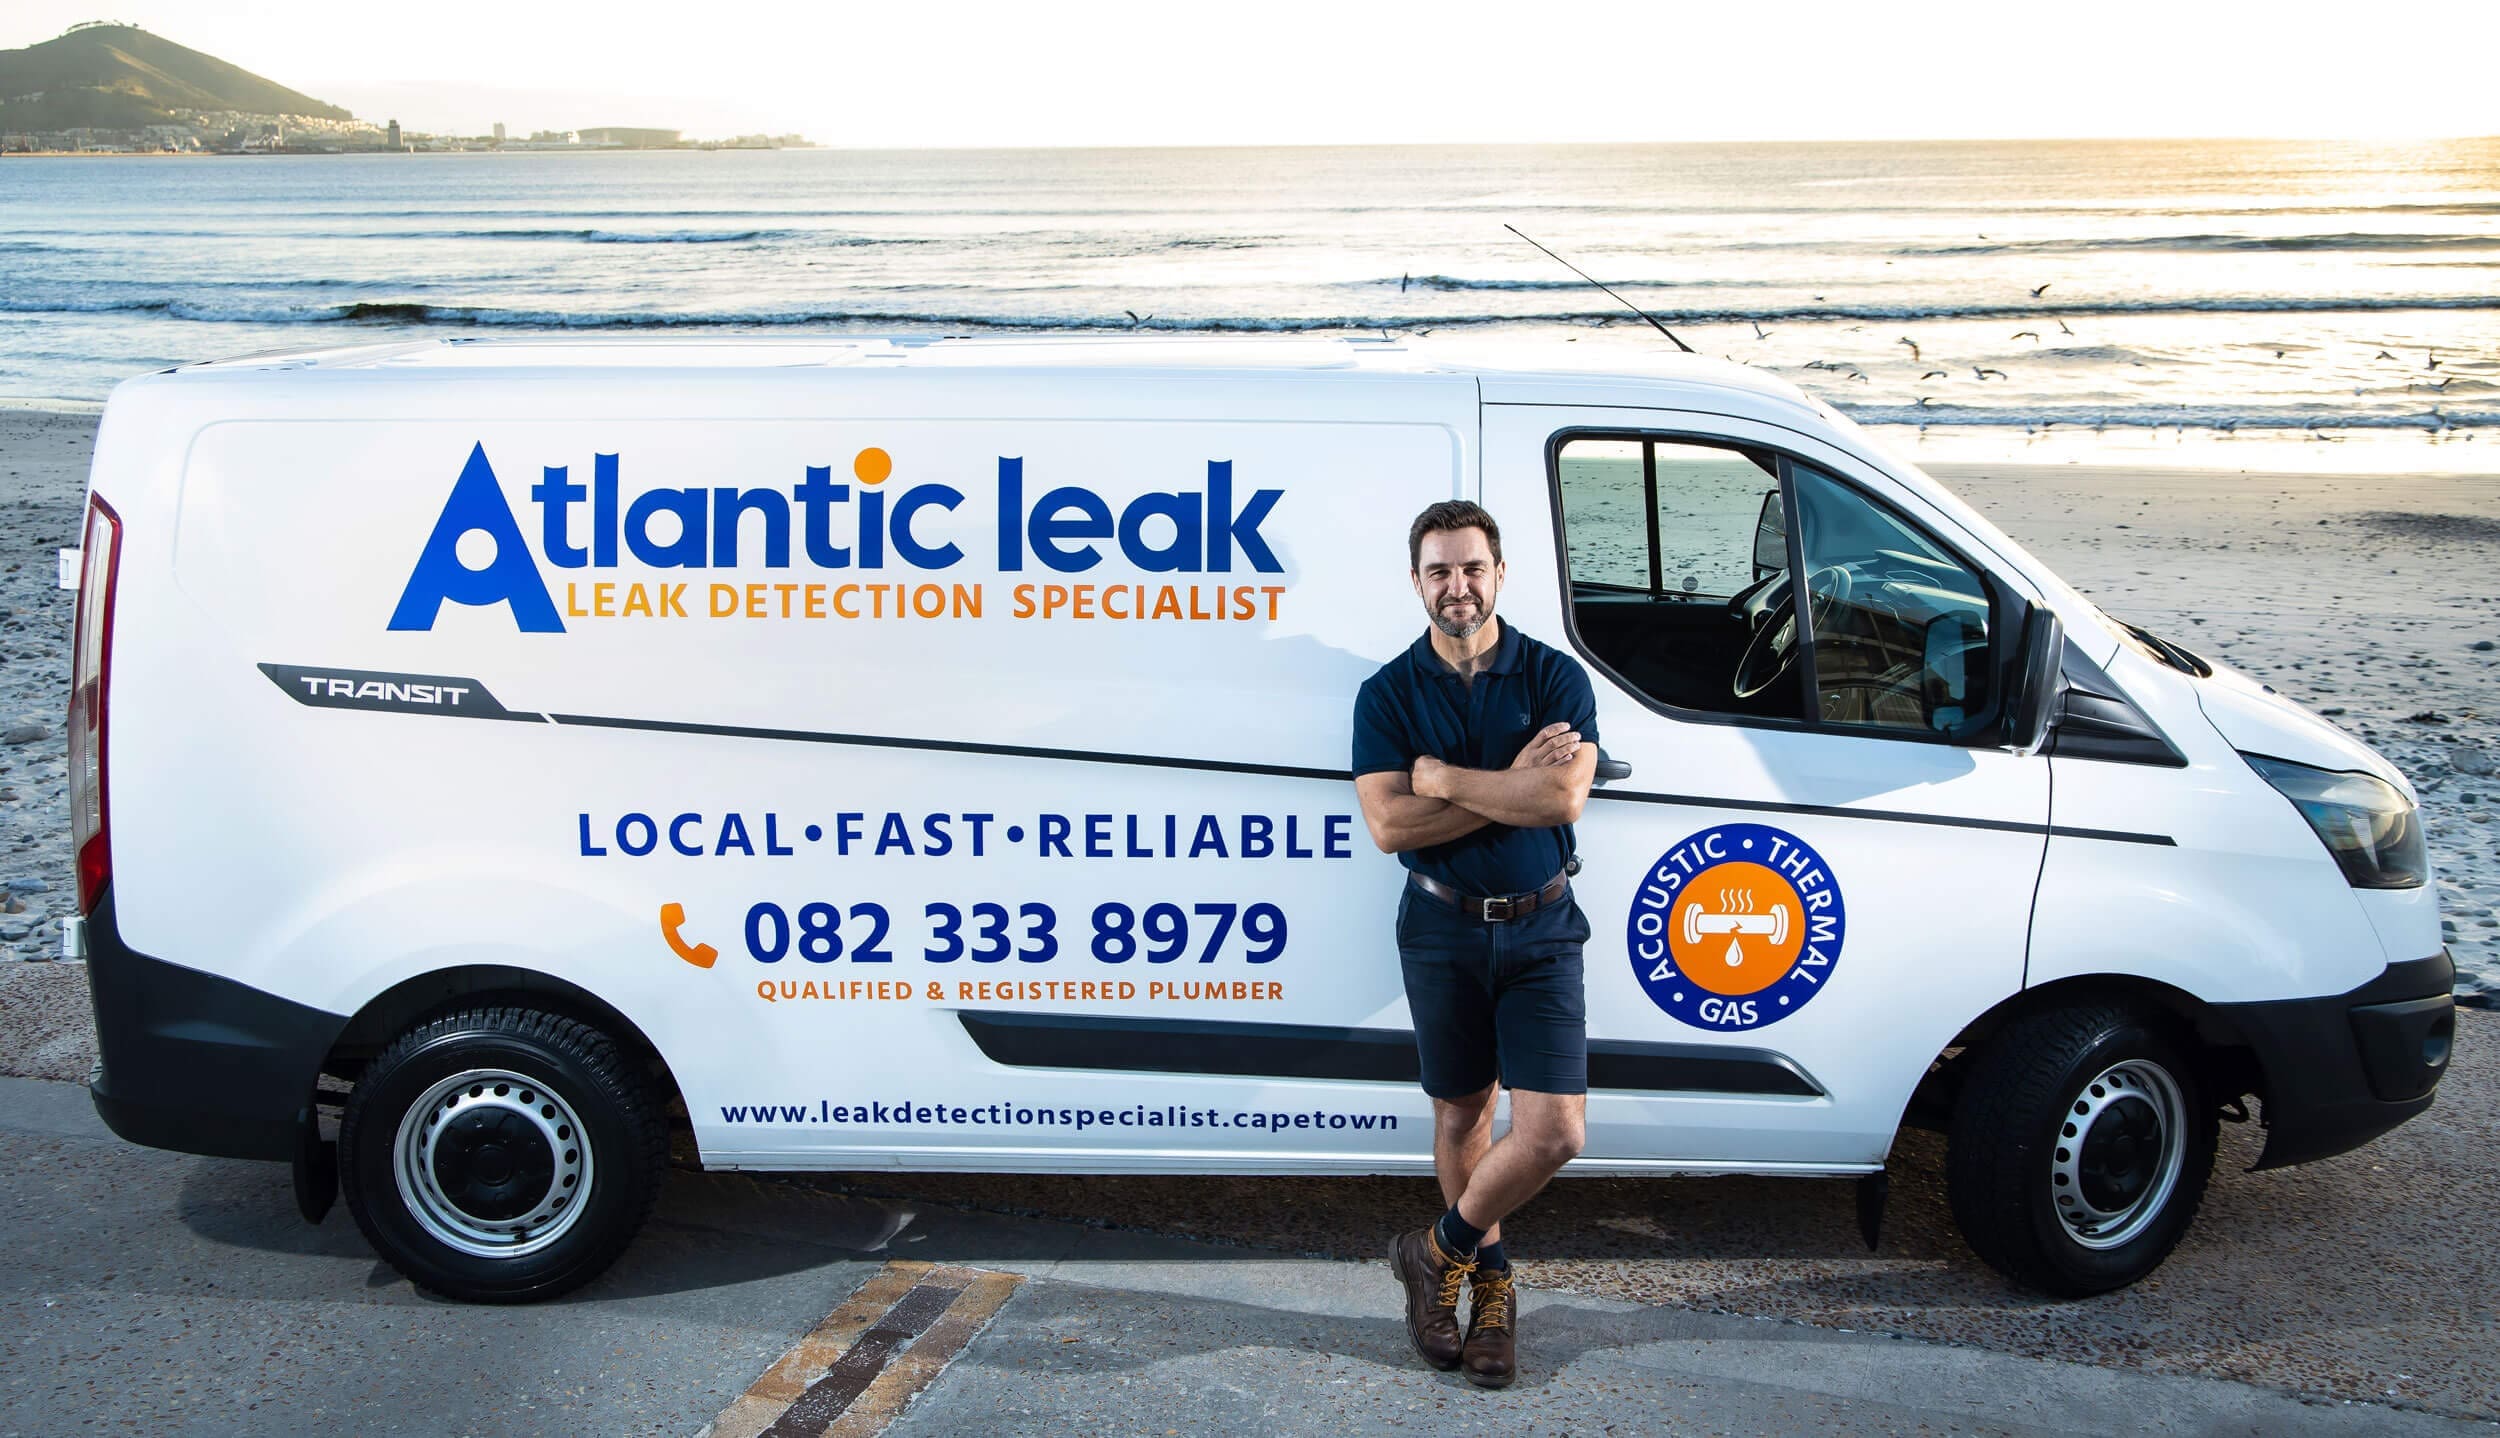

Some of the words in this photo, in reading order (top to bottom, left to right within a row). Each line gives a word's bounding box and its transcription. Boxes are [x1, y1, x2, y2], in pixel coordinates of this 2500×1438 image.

[386, 440, 965, 633] Atlantic
[998, 455, 1285, 573] leak
[567, 582, 687, 618] LEAK
[709, 583, 982, 619] DETECTION
[1013, 584, 1285, 621] SPECIALIST
[301, 676, 470, 705] TRANSIT
[1637, 833, 1728, 982] ACOUSTIC
[1767, 836, 1838, 985] THERMAL
[745, 901, 893, 964] 082
[923, 902, 1059, 964] 333
[1091, 902, 1288, 964] 8979
[756, 980, 913, 1003] QUALIFIED
[926, 981, 945, 1001] &
[958, 981, 1136, 1001] REGISTERED
[1148, 981, 1285, 1001] PLUMBER
[1699, 997, 1759, 1026] GAS
[720, 1099, 1400, 1133] www.leakdetectionspecialist.capetown
